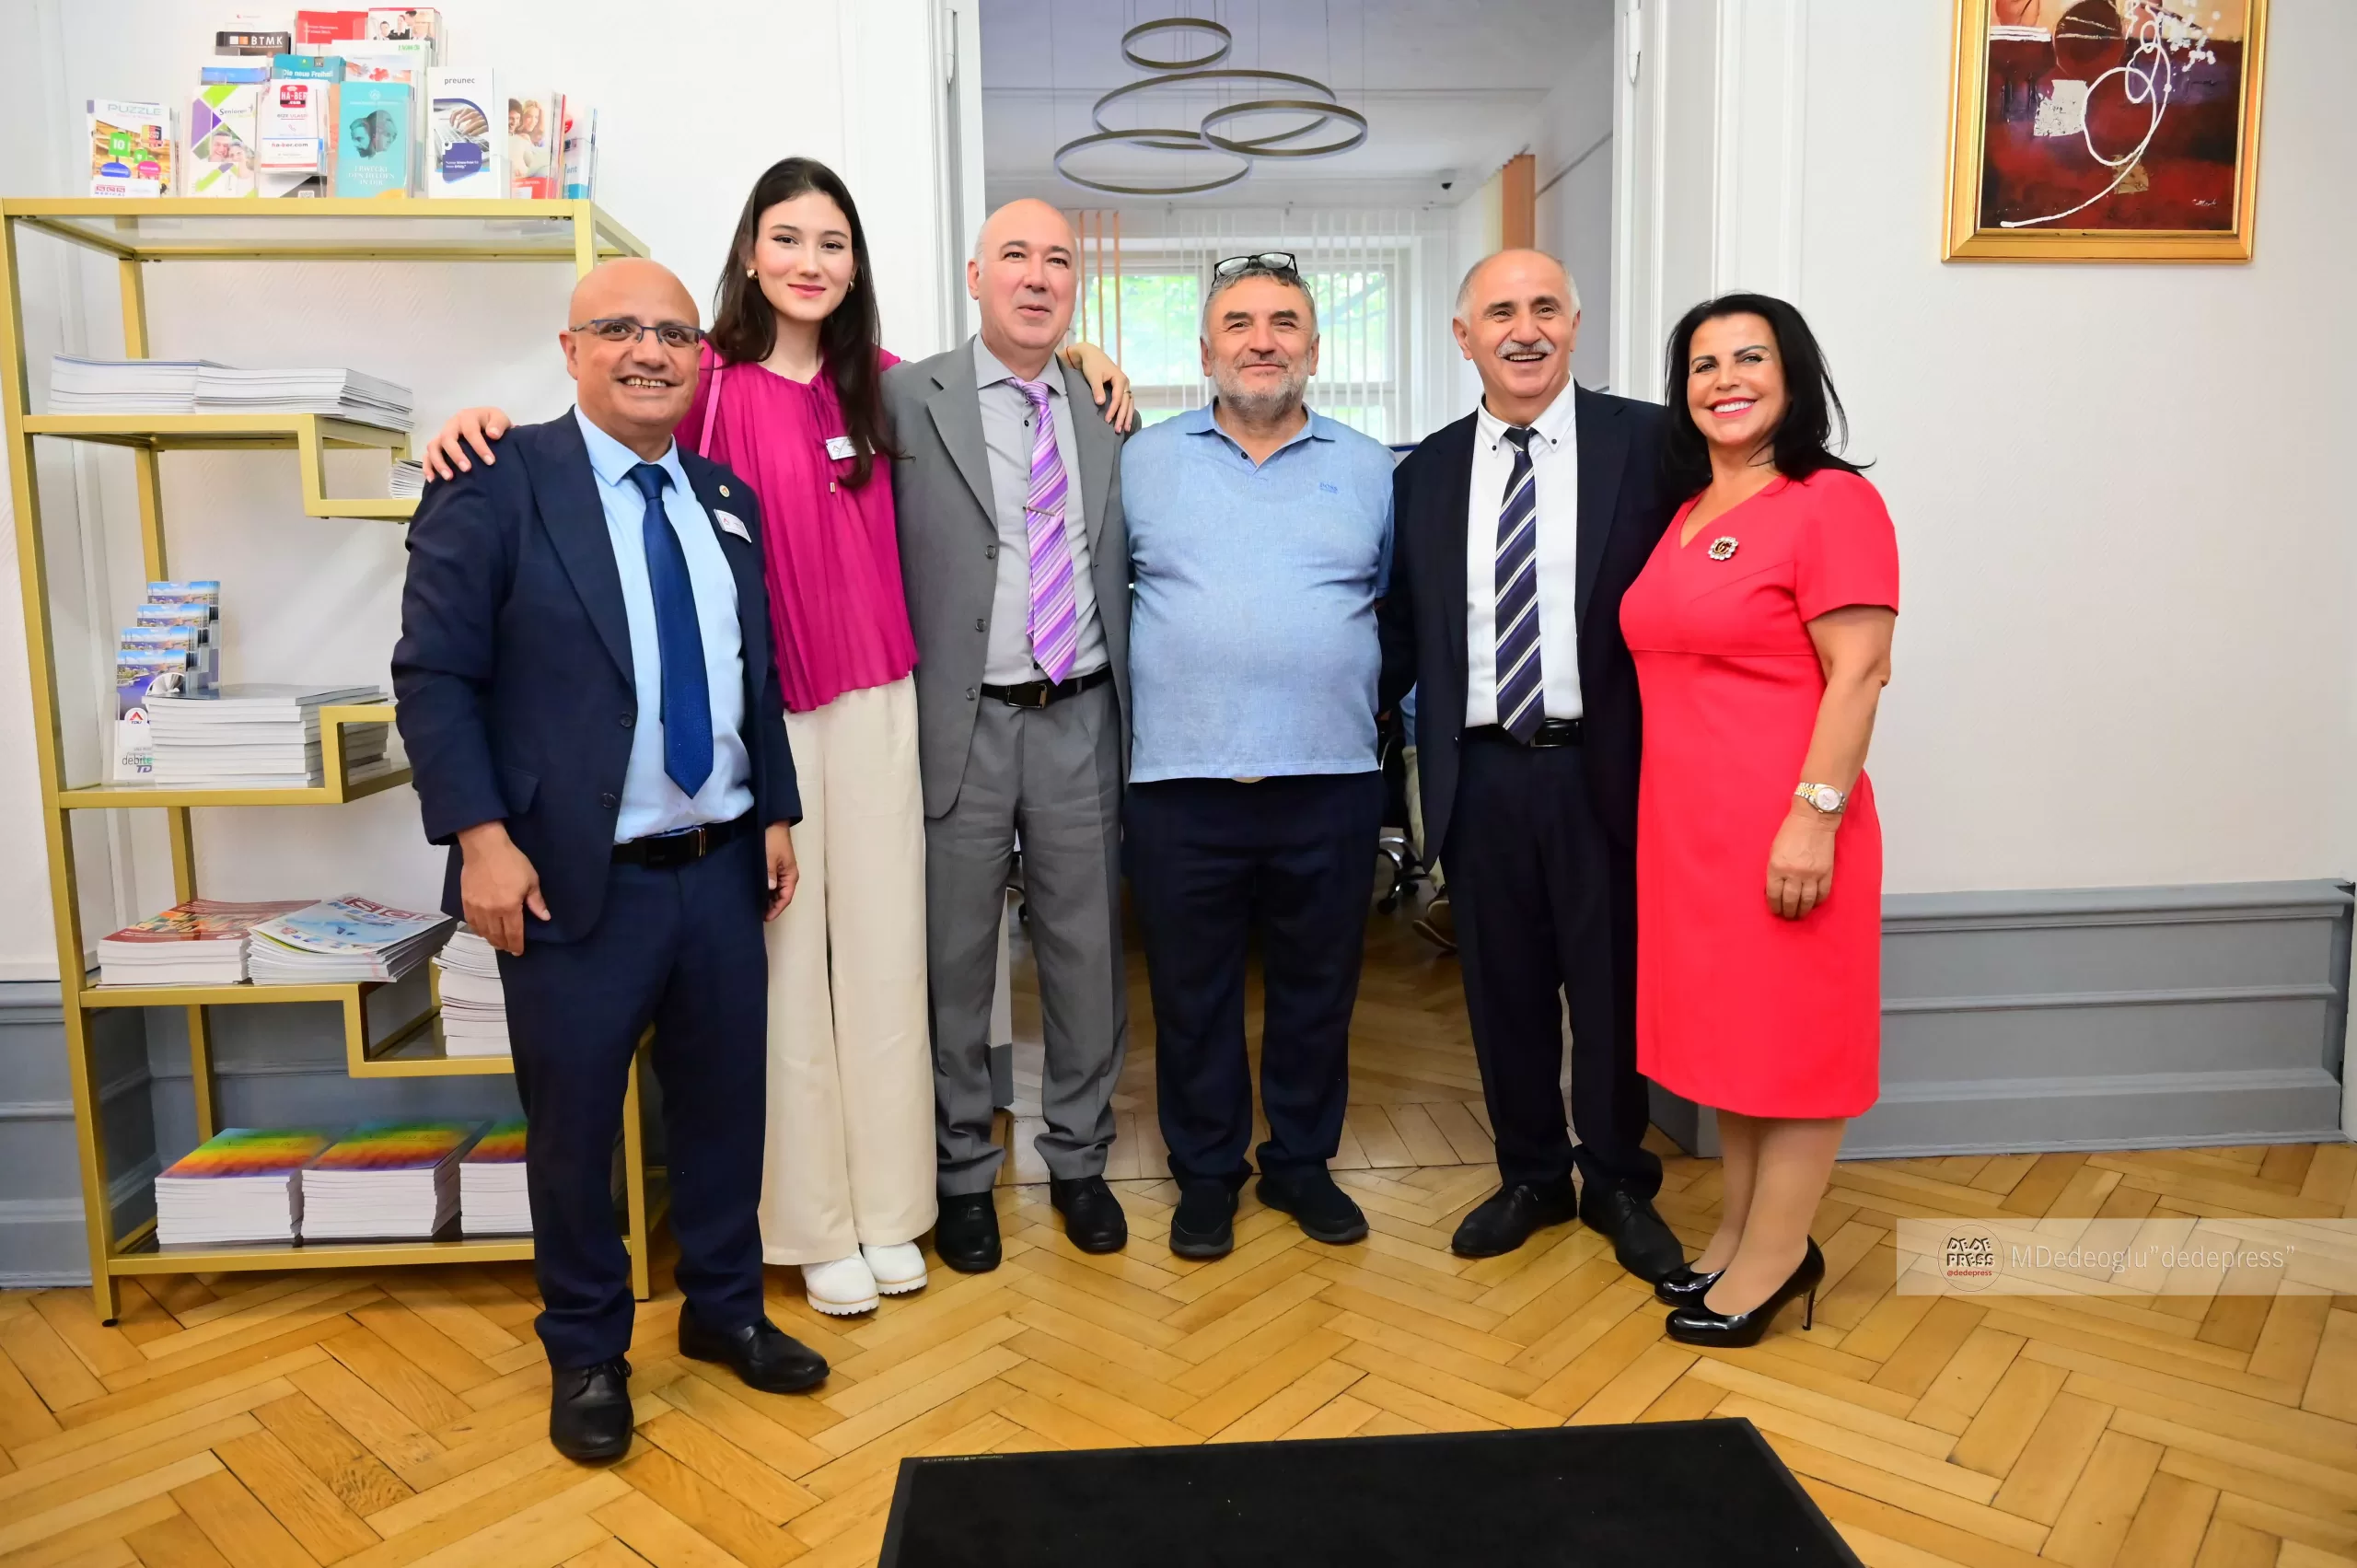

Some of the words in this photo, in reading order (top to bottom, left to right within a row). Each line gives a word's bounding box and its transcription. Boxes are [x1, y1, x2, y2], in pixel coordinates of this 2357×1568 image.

[250, 35, 283, 46] BTMK
[283, 68, 294, 77] Die
[108, 103, 162, 116] PUZZLE
[113, 138, 126, 151] 10
